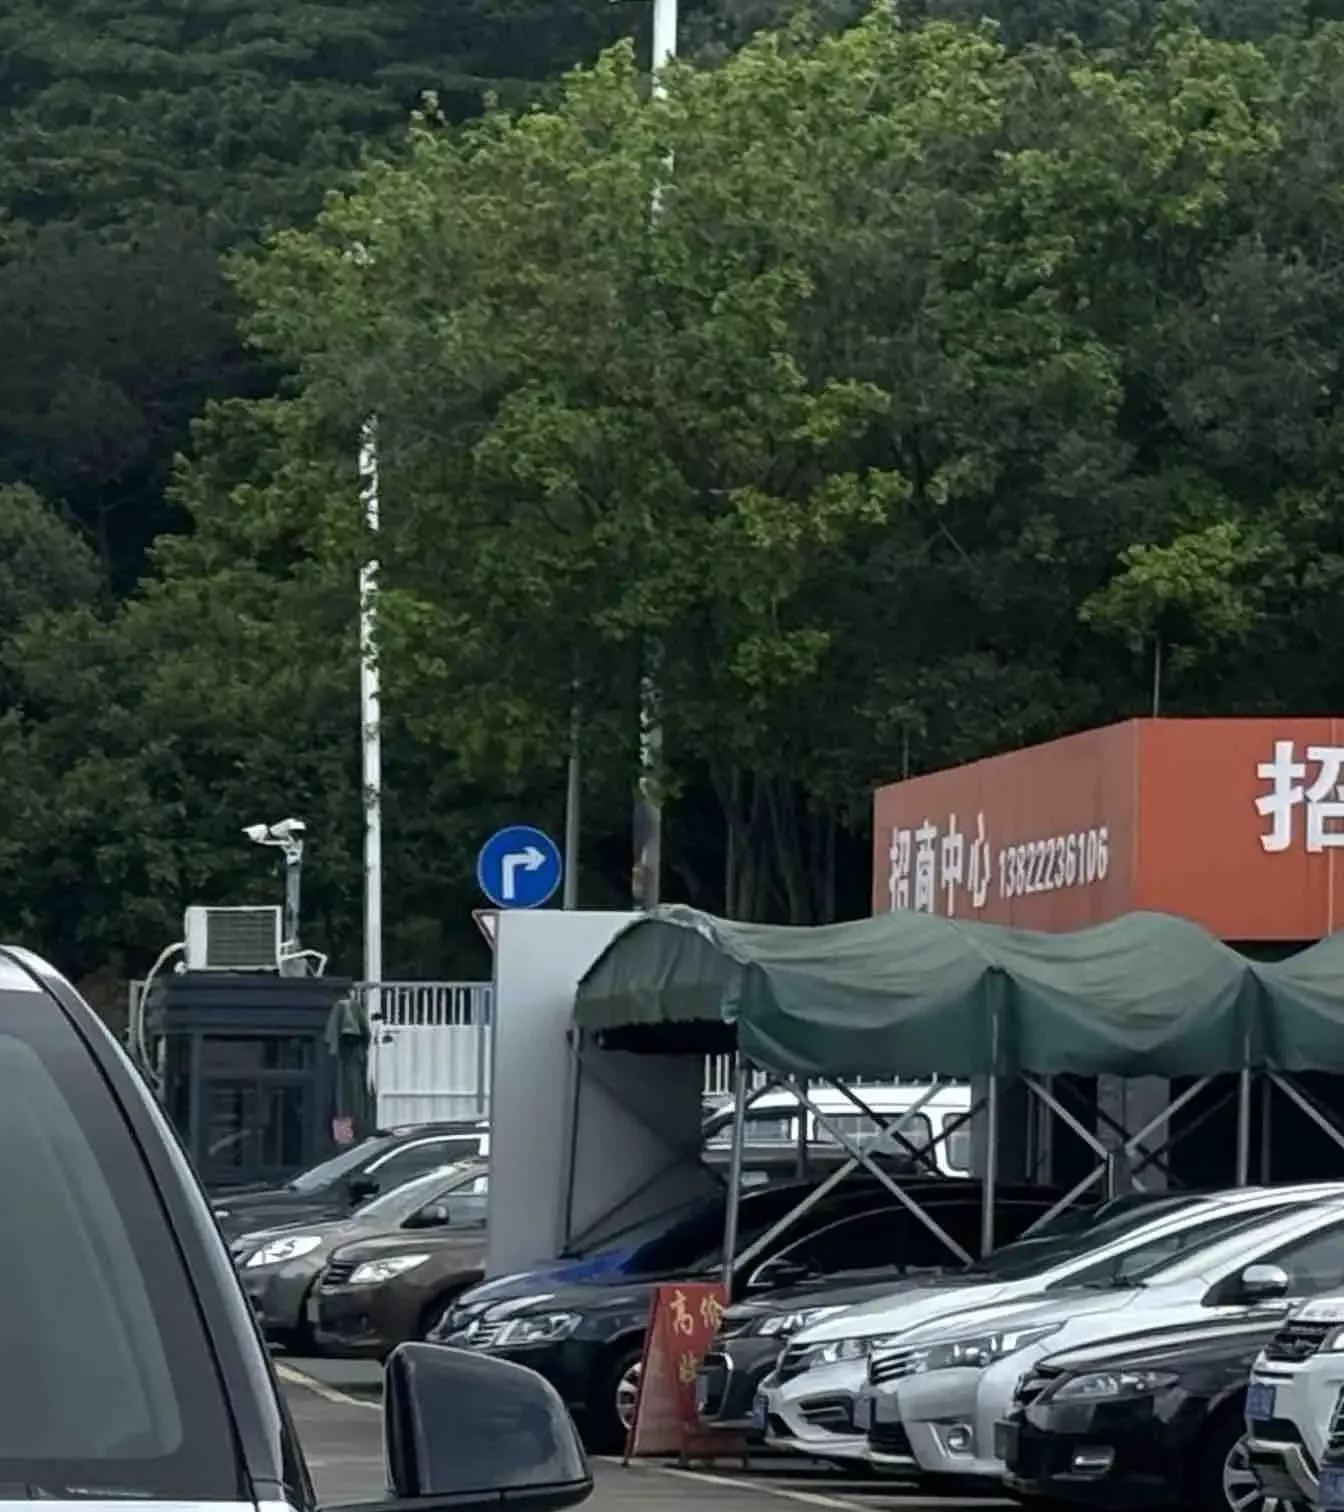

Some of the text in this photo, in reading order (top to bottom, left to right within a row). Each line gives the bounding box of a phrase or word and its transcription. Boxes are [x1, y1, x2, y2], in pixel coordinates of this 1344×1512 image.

[888, 809, 1110, 917] 招商中心 13822236106
